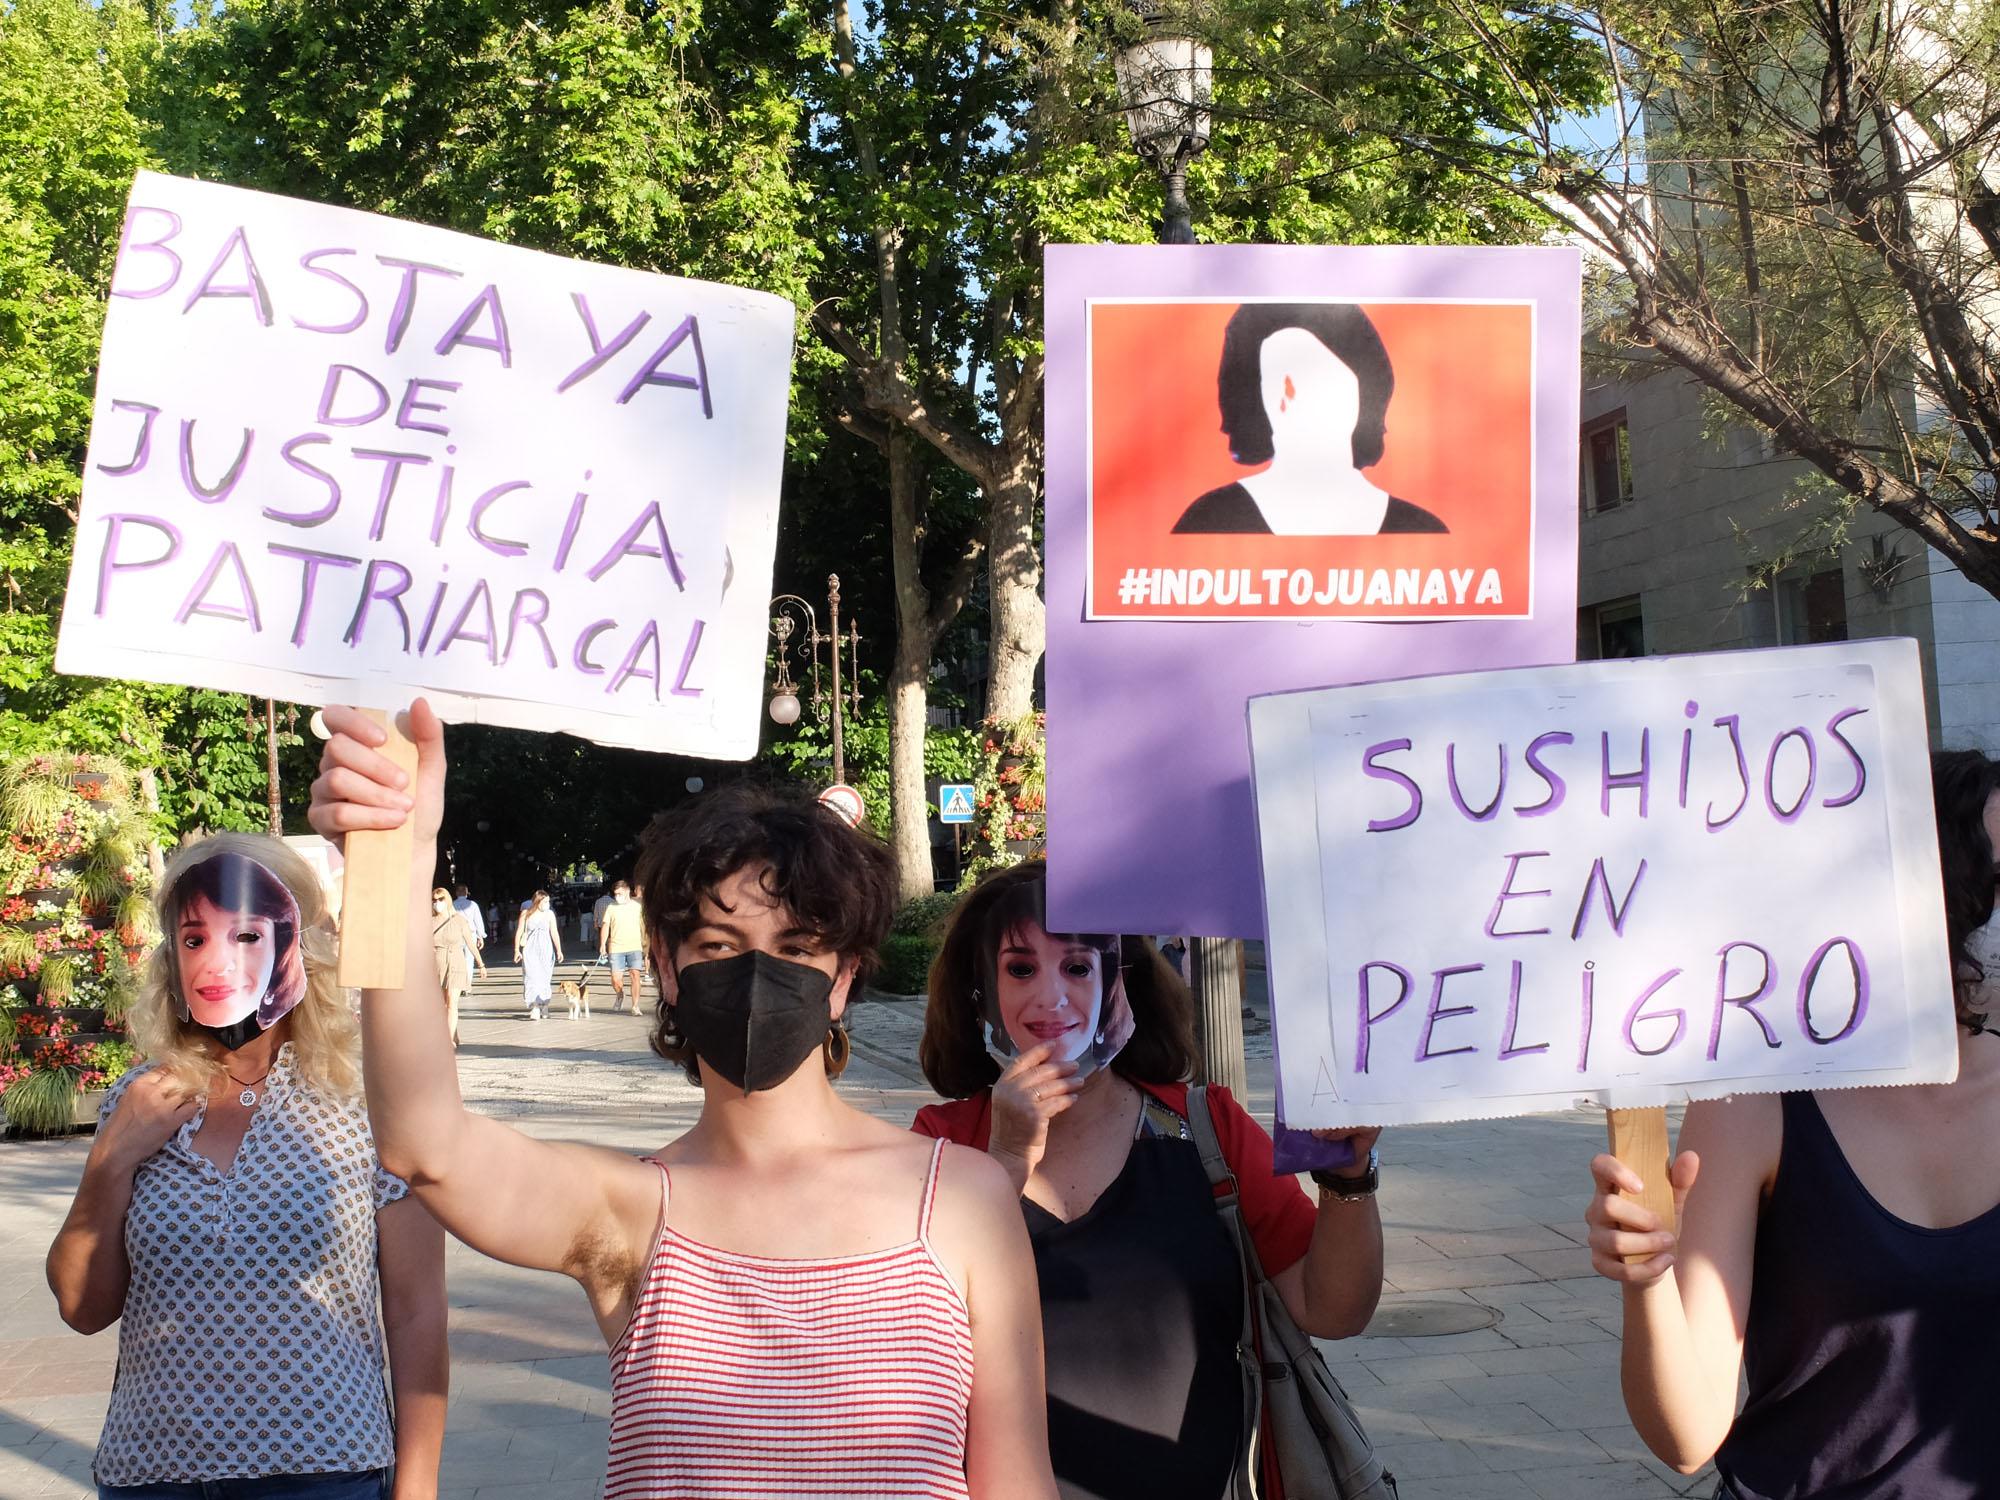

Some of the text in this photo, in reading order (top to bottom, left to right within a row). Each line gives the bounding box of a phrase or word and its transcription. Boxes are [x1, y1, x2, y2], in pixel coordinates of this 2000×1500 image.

[109, 204, 715, 421] BASTA YA
[315, 363, 464, 438] DE
[1117, 567, 1503, 606] #INDULTOJUANAYA
[1483, 849, 1649, 942] EN
